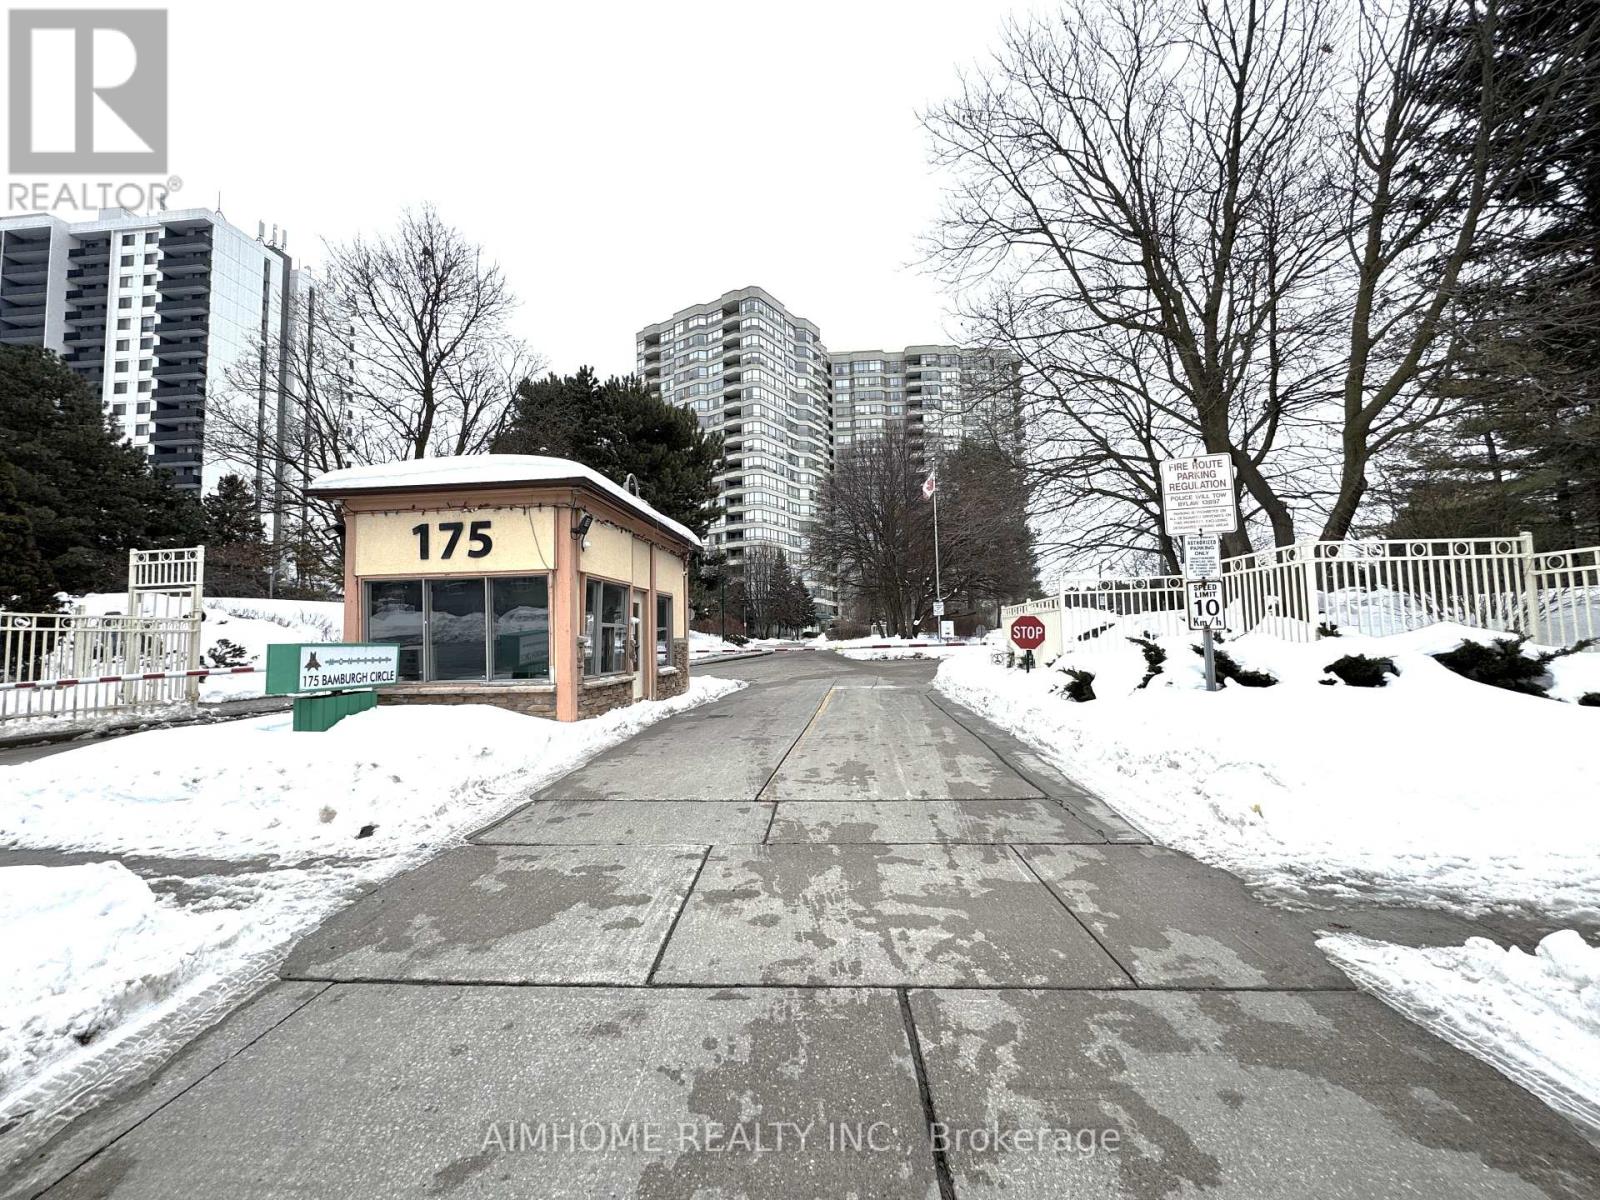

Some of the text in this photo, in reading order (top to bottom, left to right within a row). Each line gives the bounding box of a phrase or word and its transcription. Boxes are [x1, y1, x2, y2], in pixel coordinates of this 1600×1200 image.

[1169, 460, 1223, 471] FIRE ROUTE
[1177, 470, 1217, 480] PARKING
[1169, 480, 1227, 491] REGULATION
[412, 520, 493, 560] 175
[1193, 599, 1220, 616] 10
[1193, 617, 1222, 627] Km/h
[1013, 626, 1043, 639] STOP
[303, 671, 394, 687] 175 BAMBURGH CIRCLE
